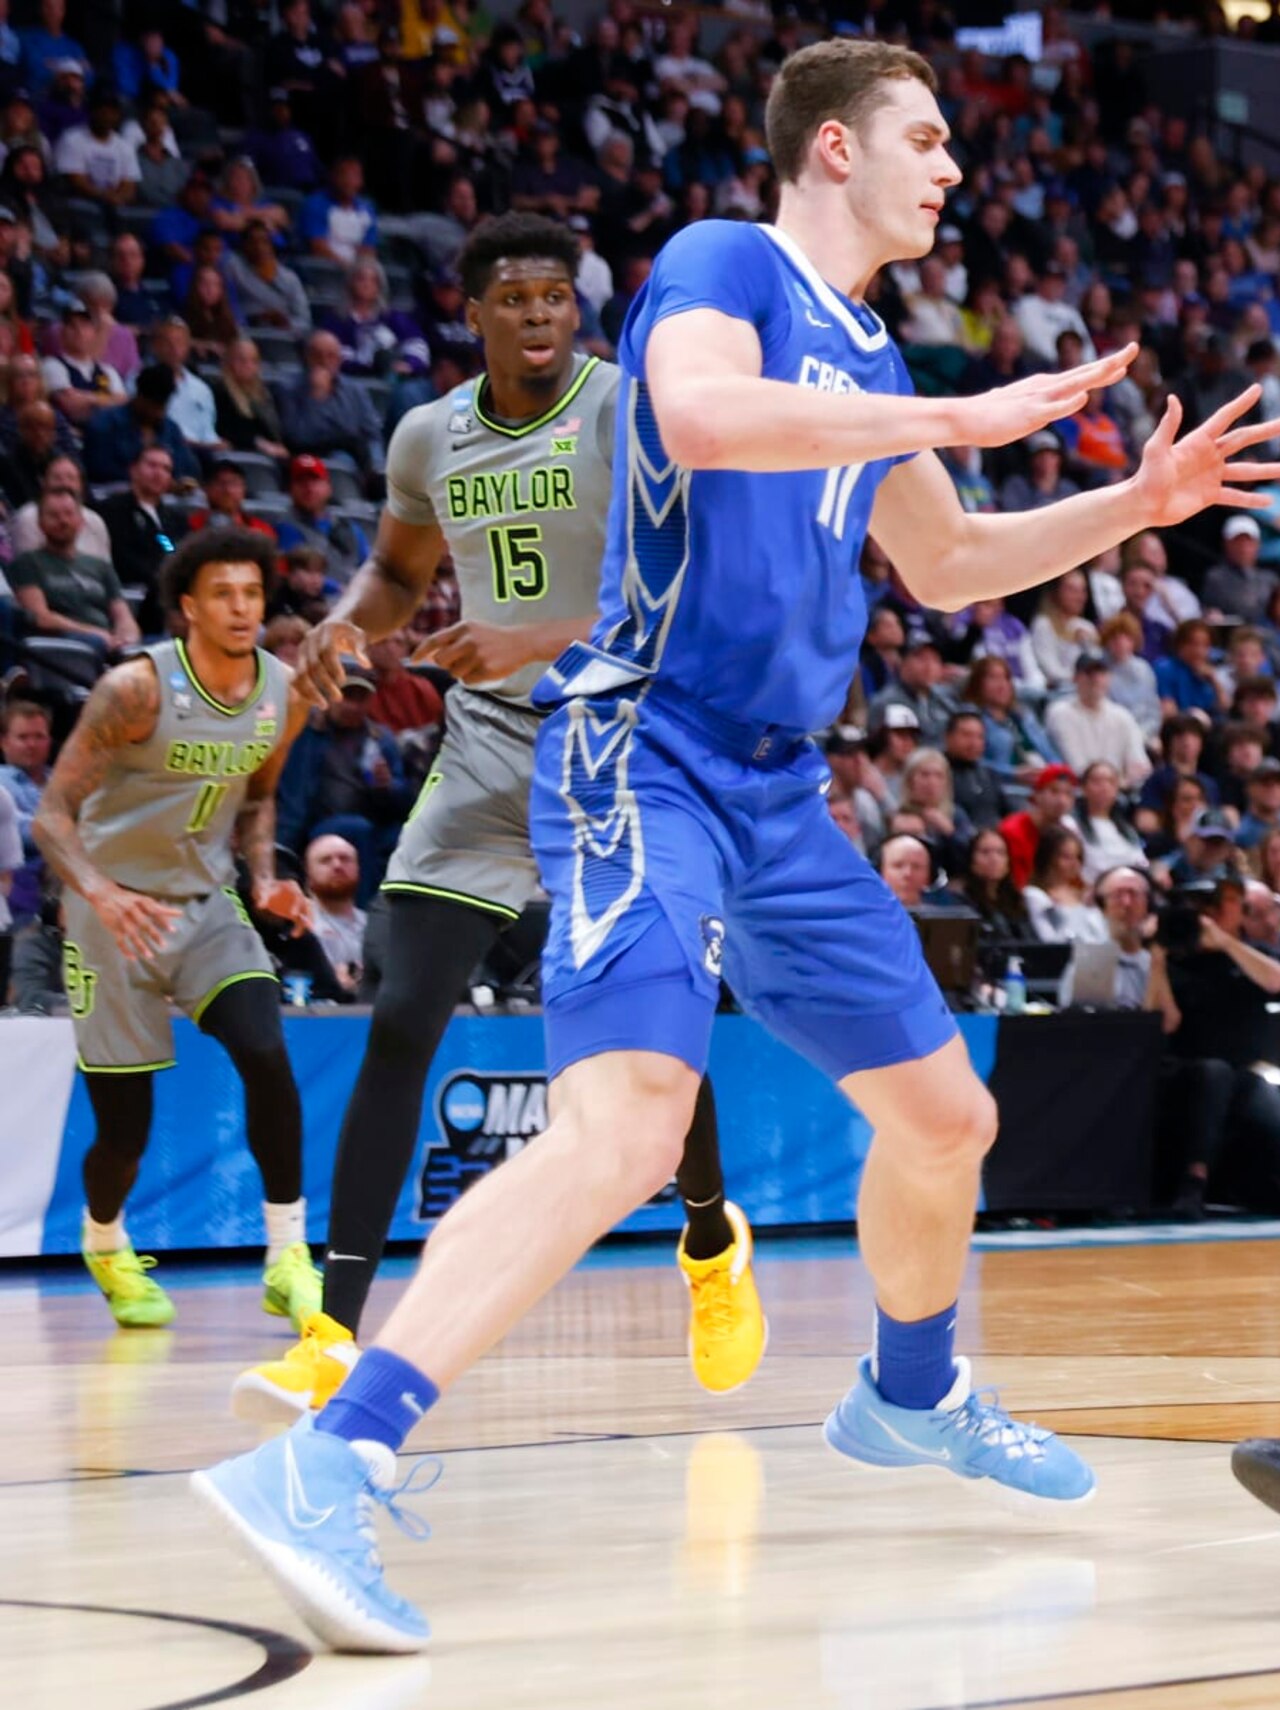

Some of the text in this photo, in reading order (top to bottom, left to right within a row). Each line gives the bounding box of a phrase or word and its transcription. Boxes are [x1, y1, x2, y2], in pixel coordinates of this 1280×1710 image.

[447, 464, 578, 522] BAYLOR
[486, 523, 548, 603] 15
[185, 780, 229, 833] 11
[482, 1083, 549, 1135] MA
